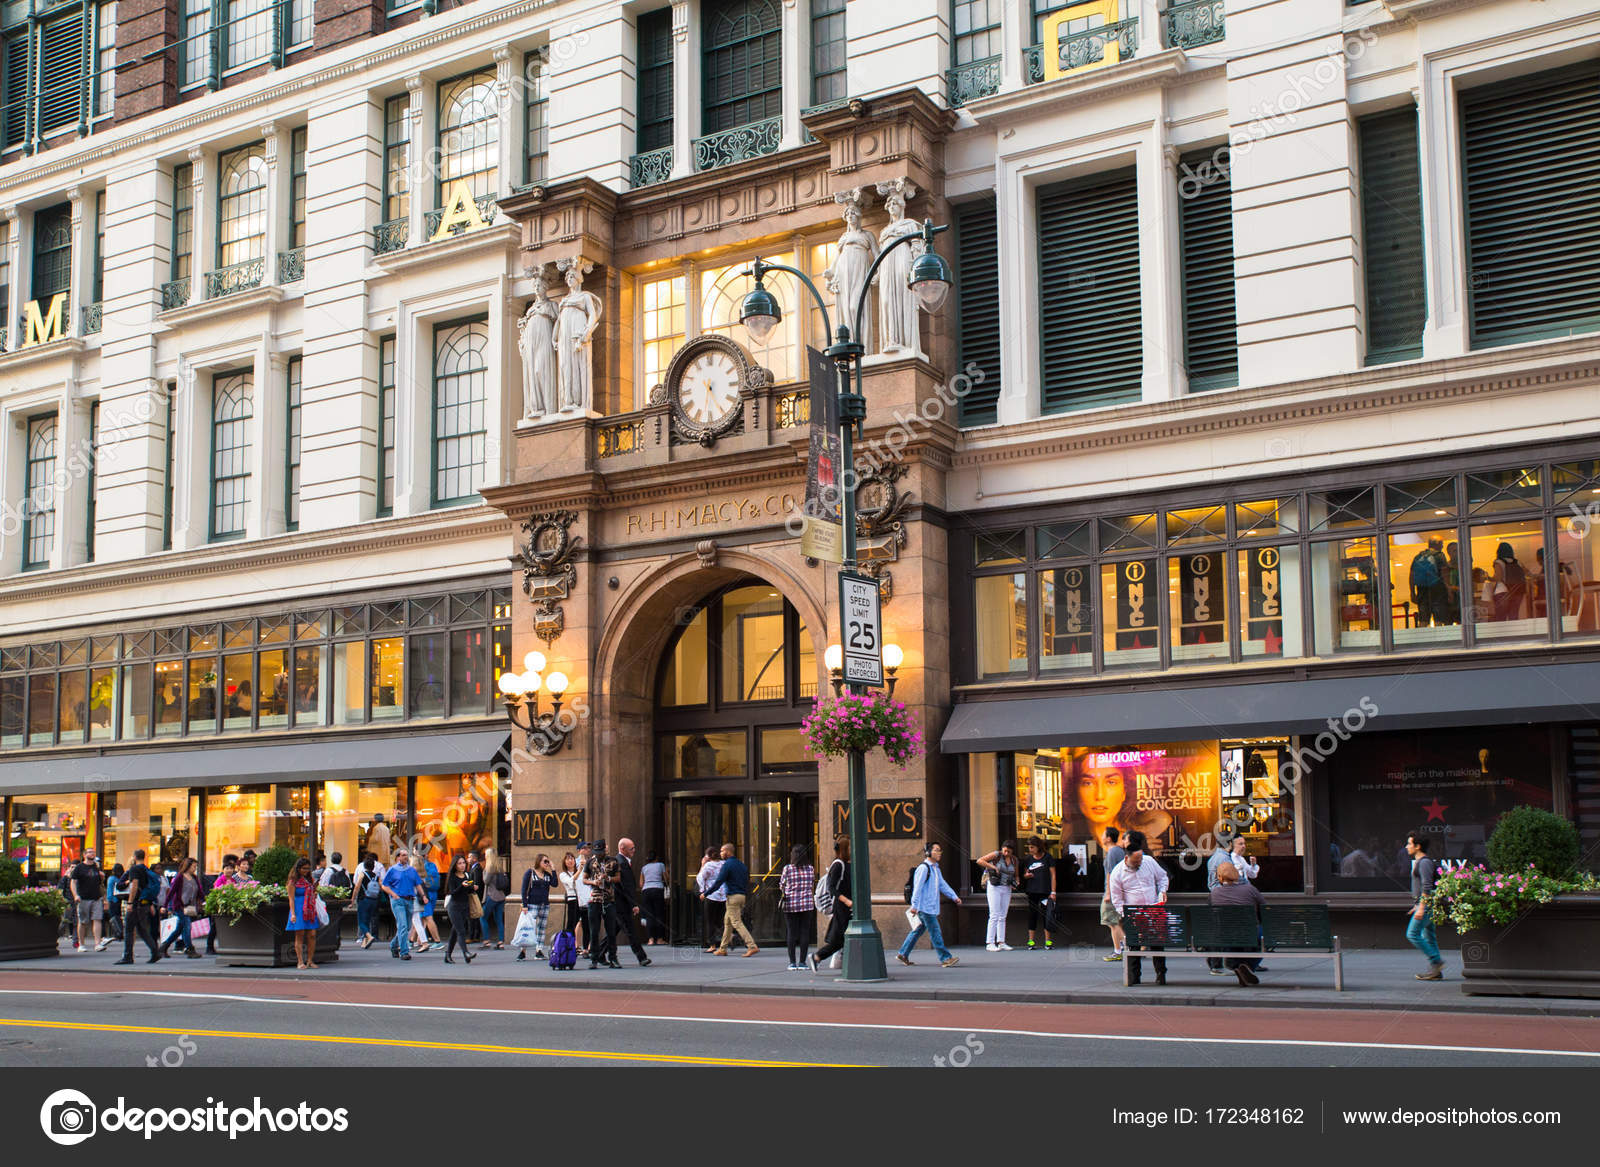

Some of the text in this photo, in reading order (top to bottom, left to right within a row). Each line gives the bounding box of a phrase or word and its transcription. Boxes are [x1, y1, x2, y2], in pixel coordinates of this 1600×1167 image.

[22, 291, 67, 349] M
[430, 178, 490, 242] A
[852, 584, 867, 595] CITY
[850, 595, 870, 607] SPEED
[852, 609, 869, 619] LIMIT
[849, 621, 875, 650] 25
[854, 659, 872, 670] PHOTO
[849, 667, 877, 679] ENFORCED
[1136, 771, 1211, 789] INSTANT
[1387, 768, 1481, 781] magic in the making
[1137, 786, 1211, 800] FULL COVER
[1136, 798, 1212, 811] CONCEALER
[837, 801, 917, 833] MCY'S
[517, 812, 580, 840] MACY'S
